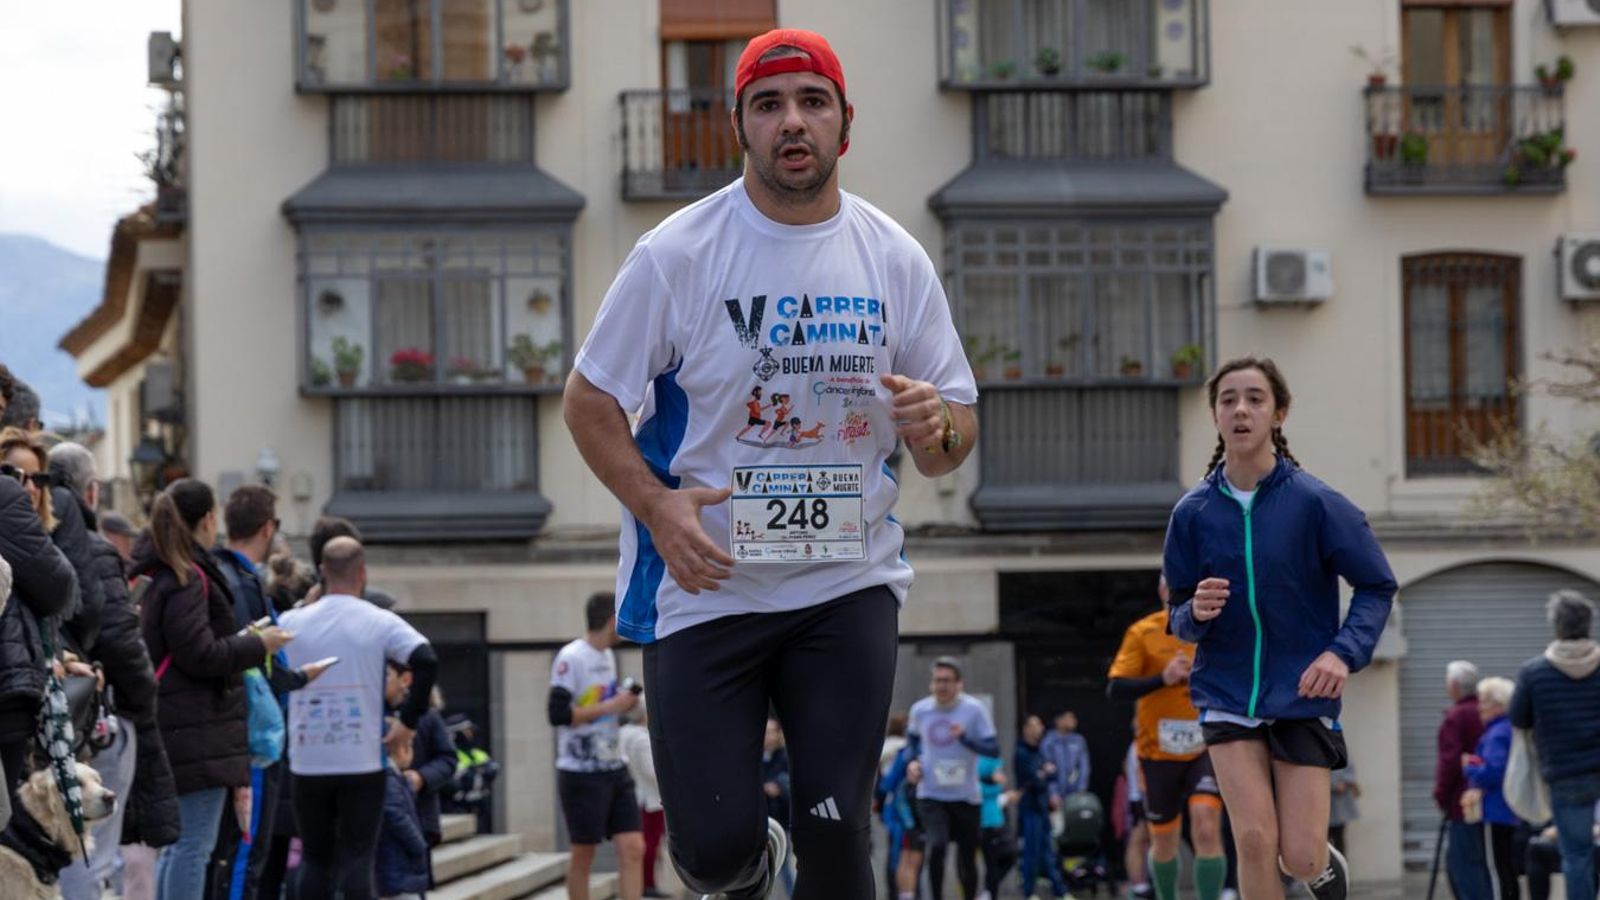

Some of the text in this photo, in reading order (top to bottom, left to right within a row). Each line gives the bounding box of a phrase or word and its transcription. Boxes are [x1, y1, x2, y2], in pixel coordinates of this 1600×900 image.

[725, 295, 767, 349] V
[830, 355, 874, 374] MUERTE
[736, 471, 813, 494] V CARRERA
[833, 473, 859, 482] BUENA
[752, 483, 813, 494] CAMINATA
[833, 483, 859, 492] MUERTE
[766, 499, 829, 530] 248
